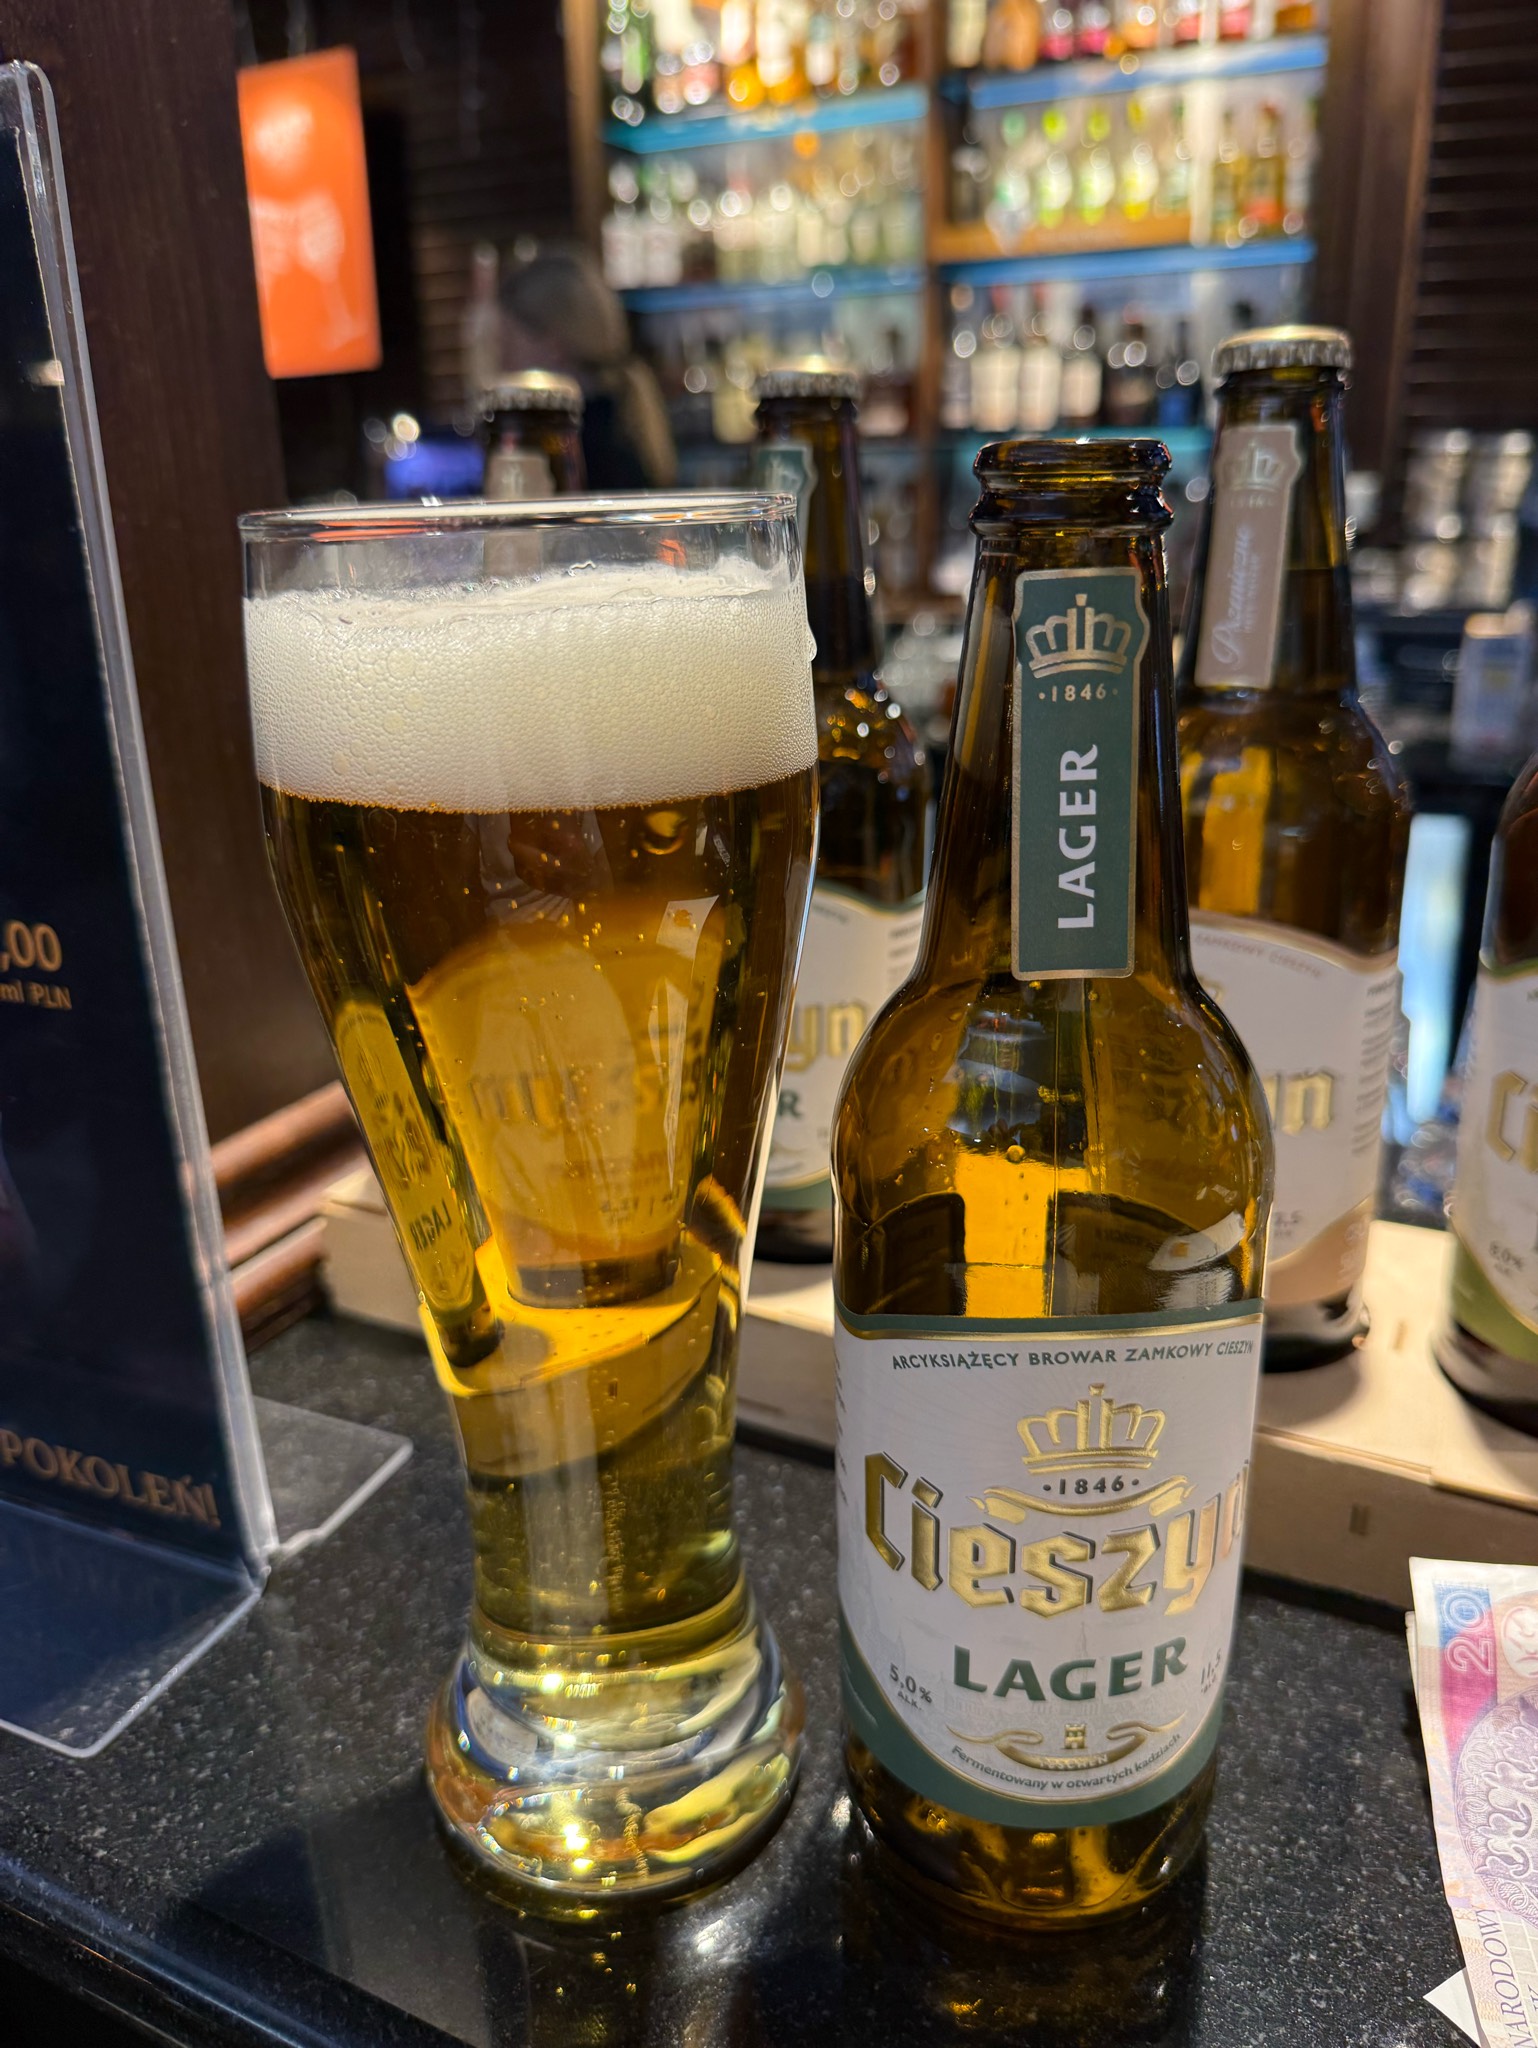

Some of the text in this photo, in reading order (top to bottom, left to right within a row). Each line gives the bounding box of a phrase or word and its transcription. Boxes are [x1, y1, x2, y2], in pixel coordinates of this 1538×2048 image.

[1058, 744, 1098, 929] LAGER
[29, 982, 73, 1010] PLN
[893, 1339, 1254, 1370] ARCYKSIĄŻĘCY BROWAR ZAMKOWY CIESZYN
[0, 1427, 221, 1530] POKOLEŃ!
[865, 1451, 1250, 1619] Cieszyn
[953, 1637, 1188, 1702] LAGER
[1442, 1590, 1494, 1676] 20
[951, 1733, 1181, 1790] Fermentowany w otwartych kadziach
